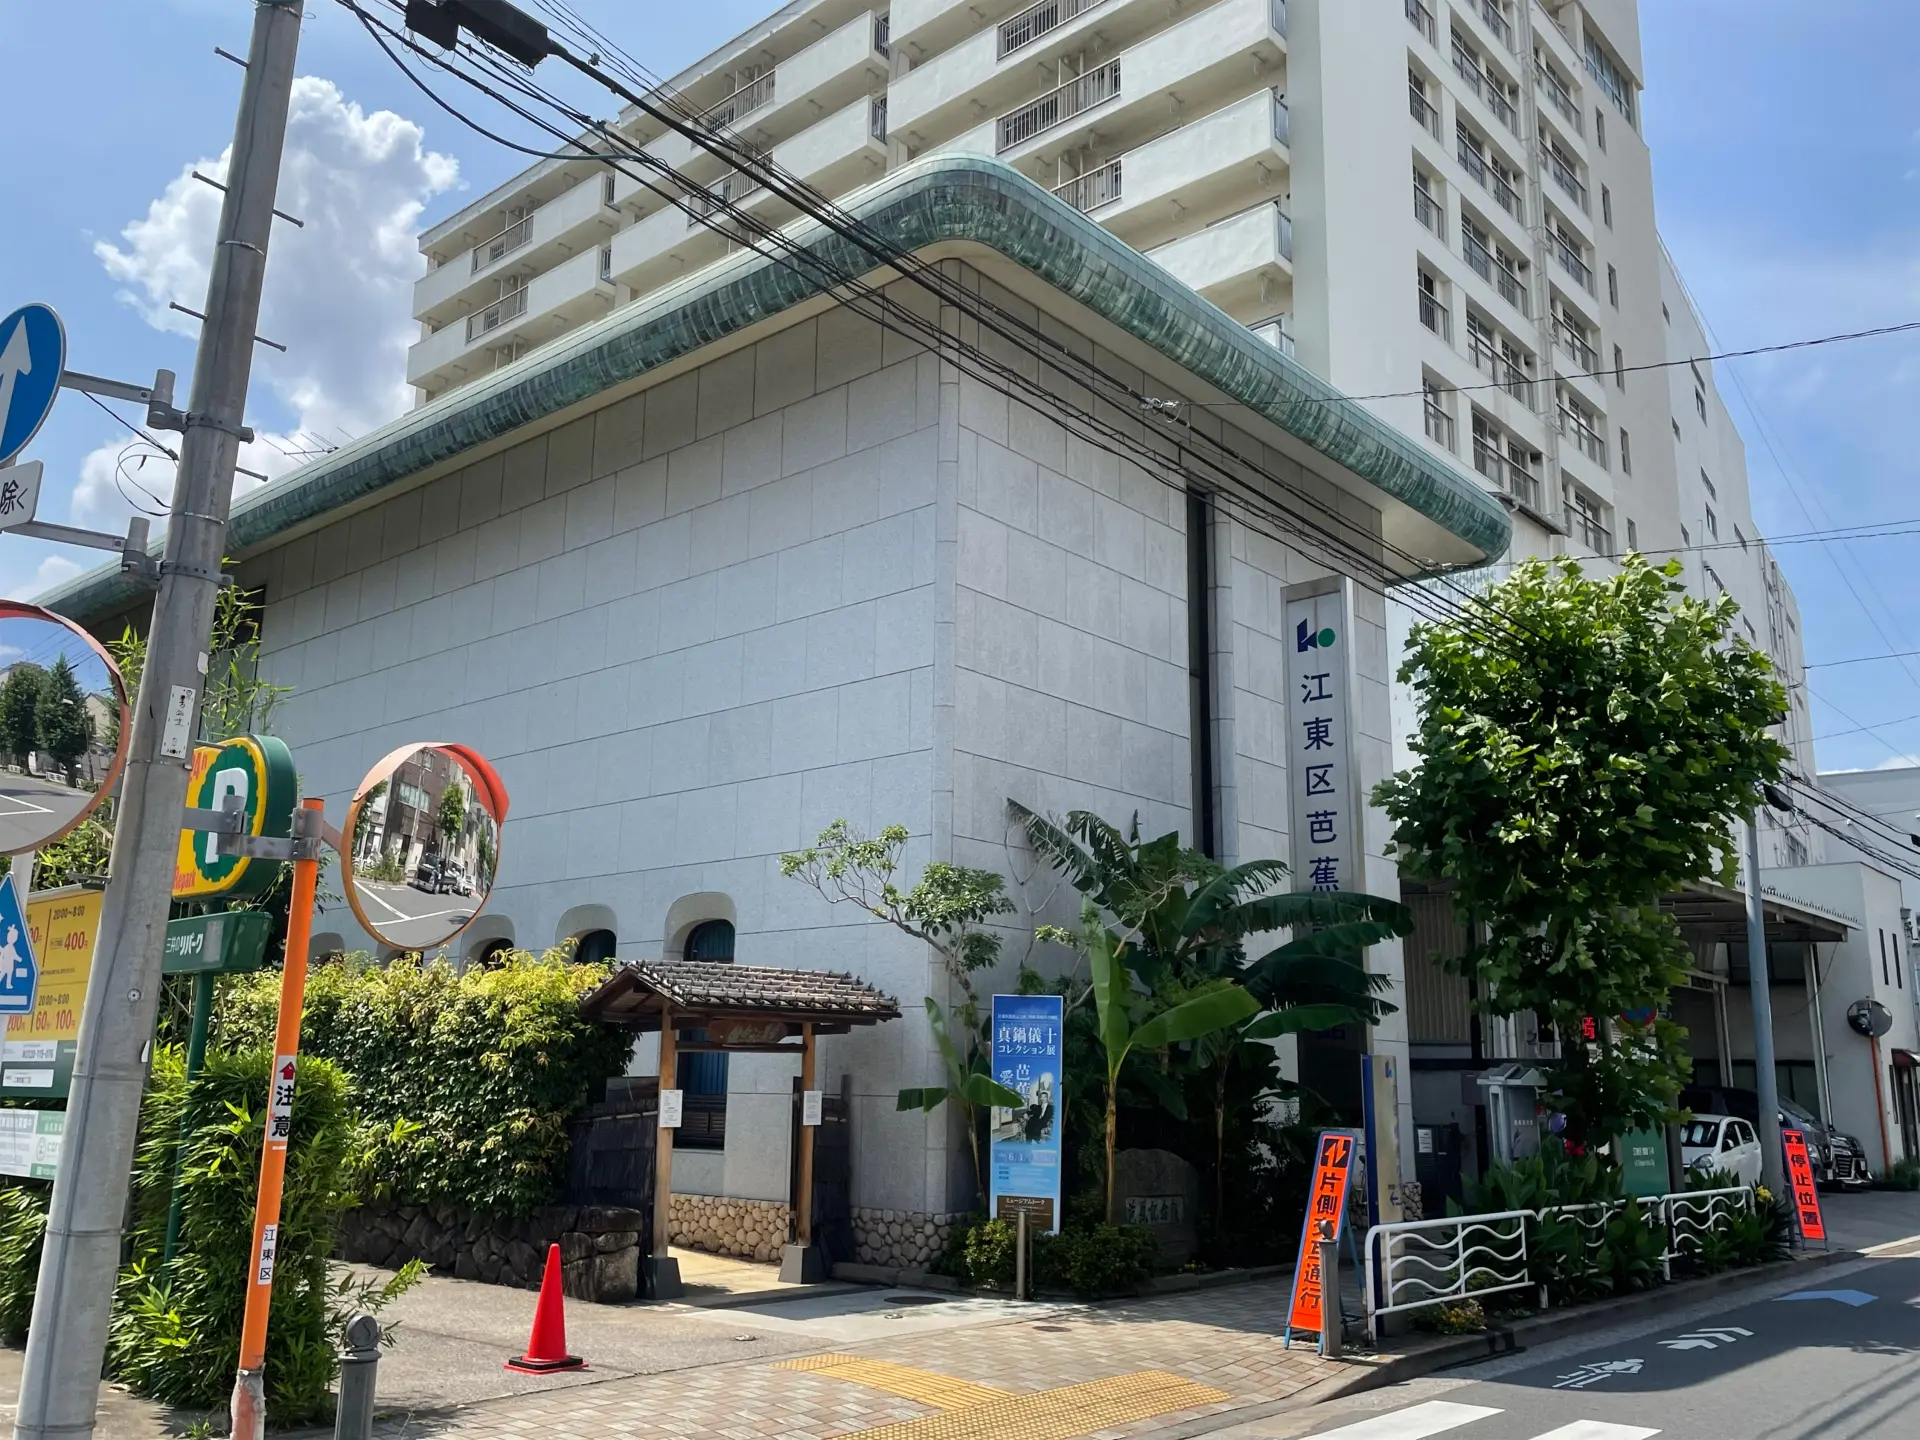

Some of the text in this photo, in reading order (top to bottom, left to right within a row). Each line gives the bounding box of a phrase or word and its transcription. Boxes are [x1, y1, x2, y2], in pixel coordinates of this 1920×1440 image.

[0, 479, 28, 515] 除く
[1301, 672, 1340, 933] 江東区芭蕉
[997, 1026, 1058, 1044] 真鍋儀十
[998, 1044, 1056, 1055] コレクション展
[272, 1085, 294, 1137] 注意
[1790, 1154, 1819, 1226] 停止位置
[260, 1228, 275, 1280] 江東区
